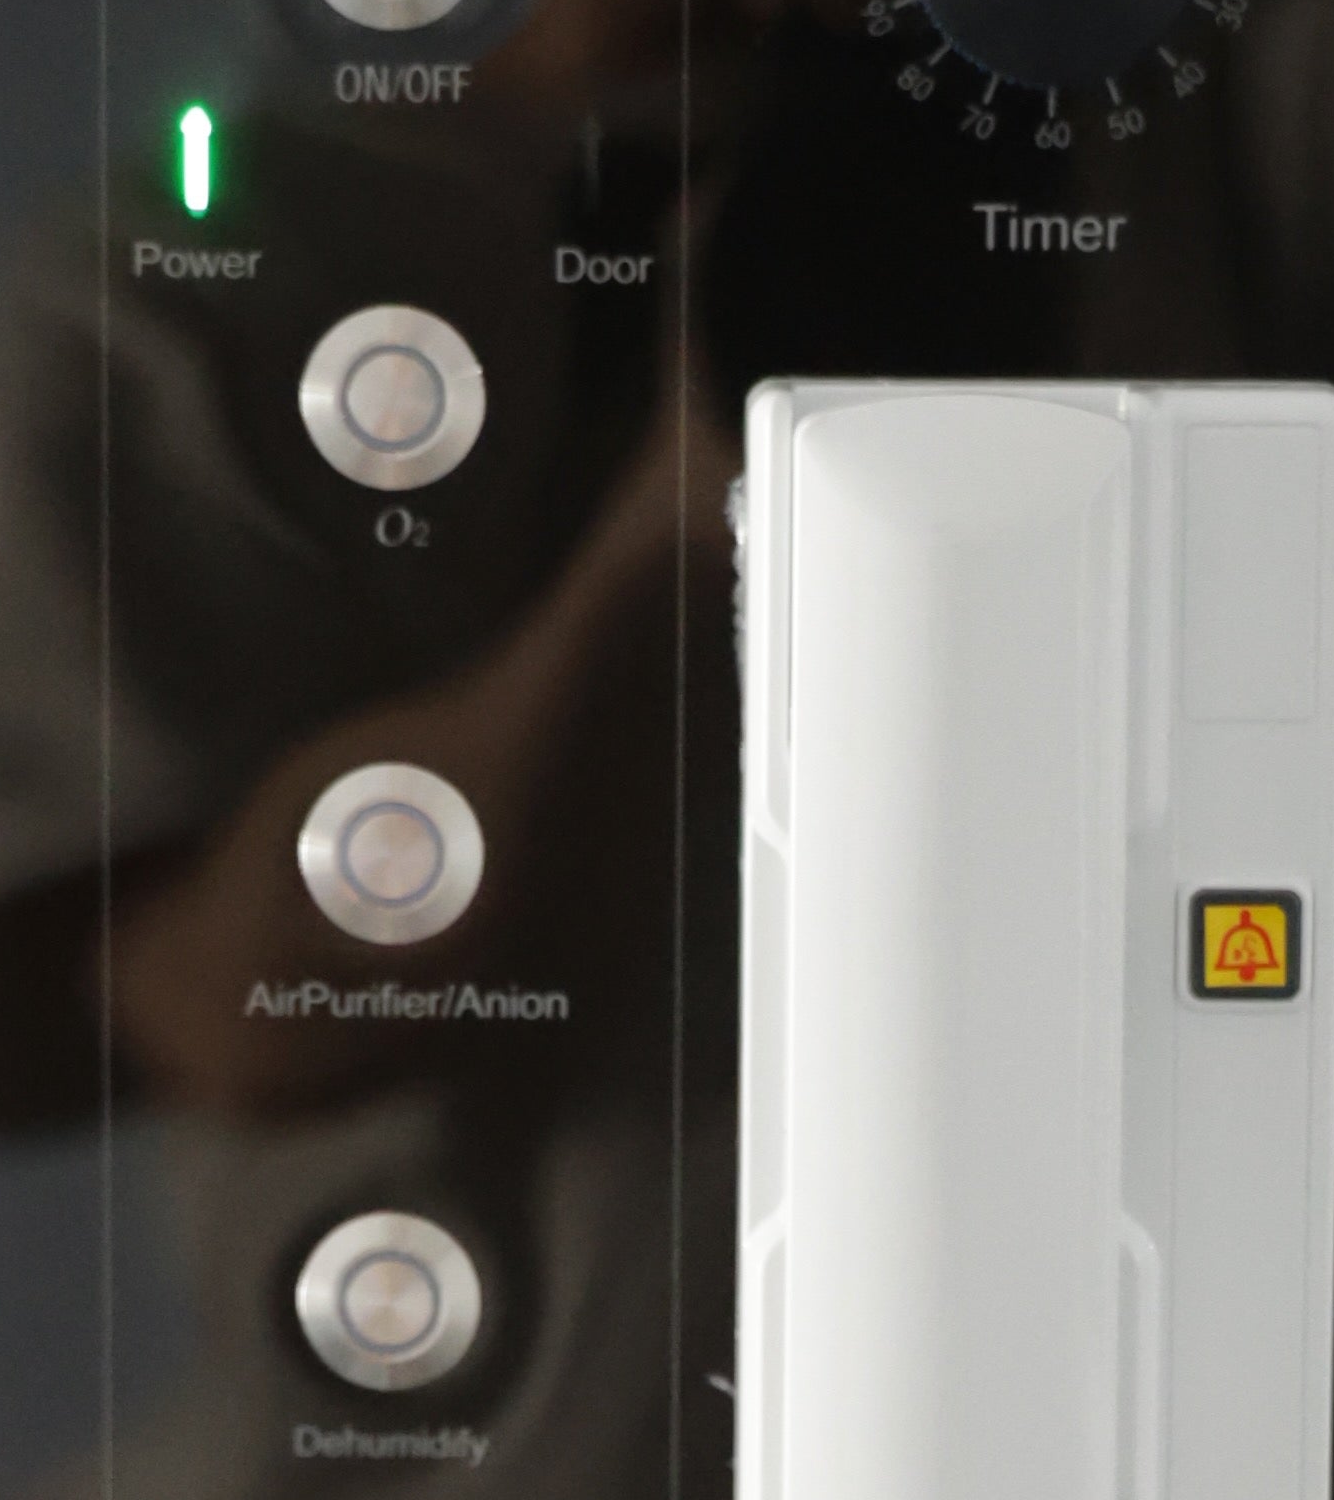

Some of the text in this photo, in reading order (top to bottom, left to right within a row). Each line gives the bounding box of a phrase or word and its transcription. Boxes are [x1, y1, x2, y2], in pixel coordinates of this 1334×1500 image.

[335, 63, 473, 104] ON/OFF
[896, 63, 935, 102] 80
[960, 104, 997, 141] 70
[1034, 119, 1072, 150] 60
[1107, 108, 1145, 141] 50
[973, 203, 1127, 252] Timer
[133, 241, 263, 279] Power
[554, 245, 654, 285] Door
[243, 981, 571, 1021] AirPurifier/Anion
[291, 1423, 491, 1469] Dehumidify
